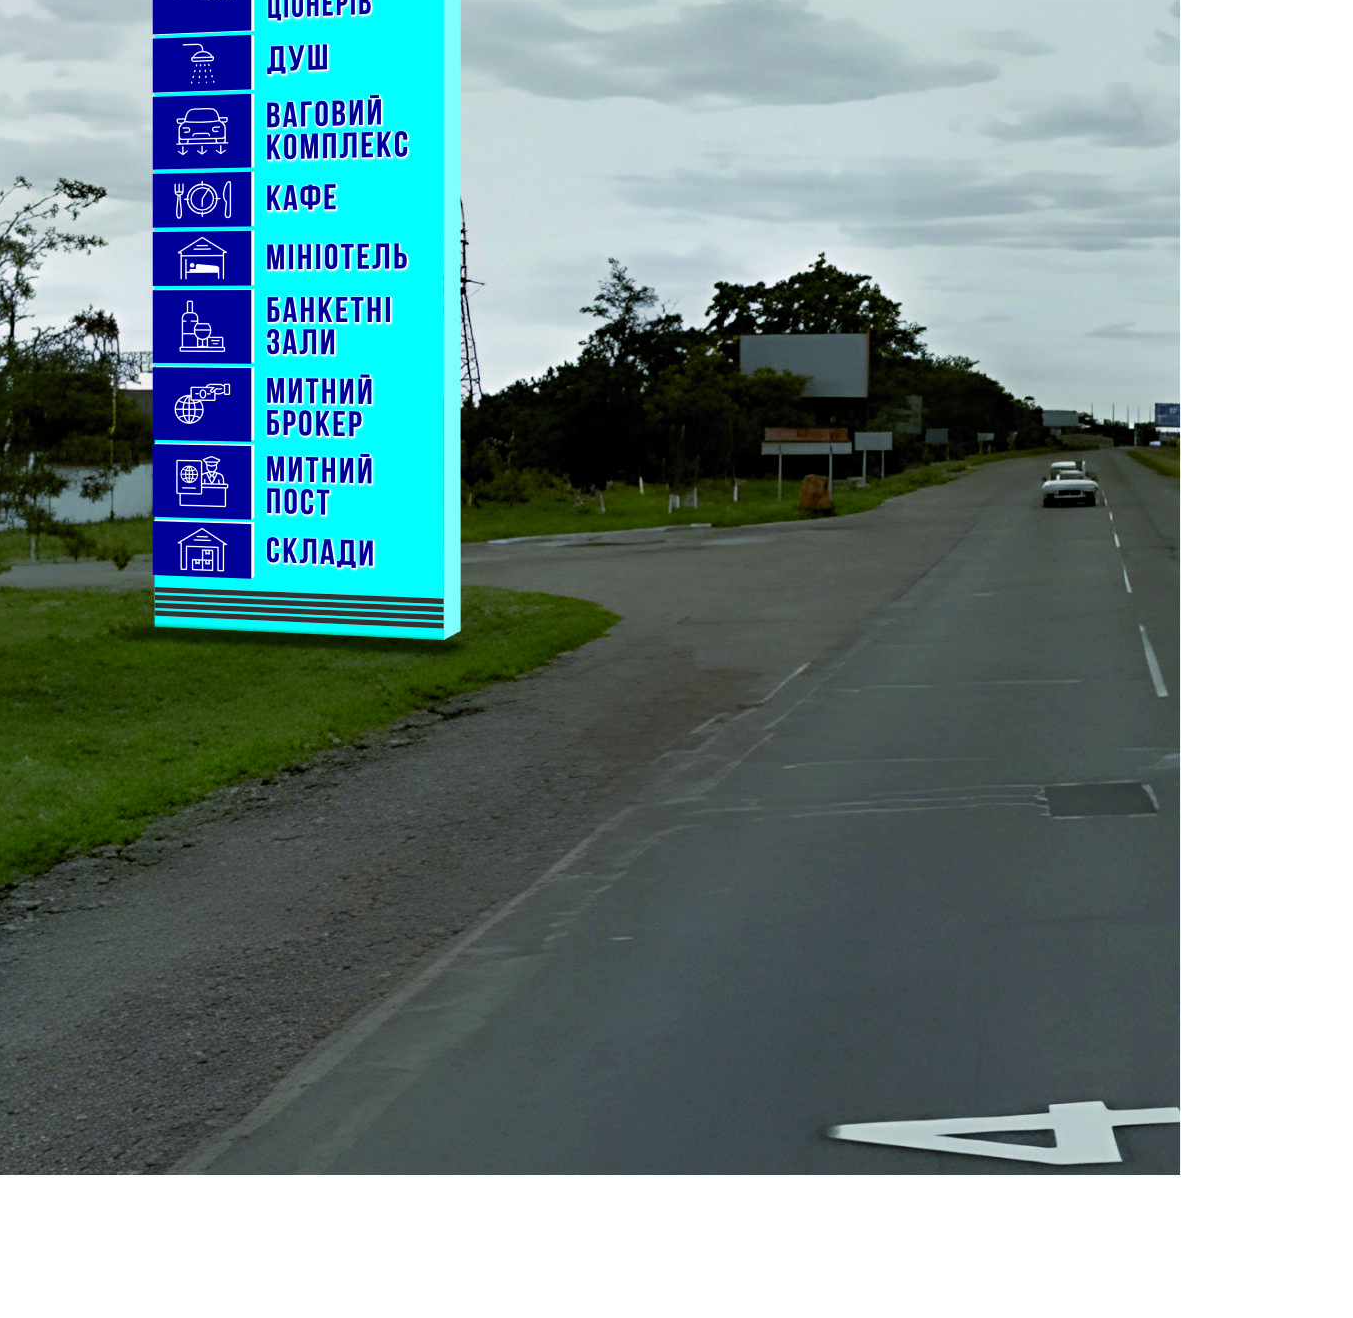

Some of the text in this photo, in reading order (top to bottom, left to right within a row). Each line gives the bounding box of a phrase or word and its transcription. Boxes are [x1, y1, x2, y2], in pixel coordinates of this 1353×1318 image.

[266, 43, 328, 75] ДУШ
[266, 94, 382, 128] ВАГОВИЙ
[266, 130, 408, 160] КОМПЛЕКС
[266, 183, 337, 211] КАФЕ
[266, 242, 408, 270] МІНІОТЕЛЬ
[267, 296, 391, 323] БАНКЕТНІ
[266, 328, 335, 355] ЗАЛИ
[266, 373, 372, 405] МИТНИЙ
[266, 409, 363, 437] БРОКЕР
[266, 453, 372, 484] МИТНИЙ
[266, 487, 330, 516] ПОСТ
[266, 536, 374, 569] СКЛАДИ
